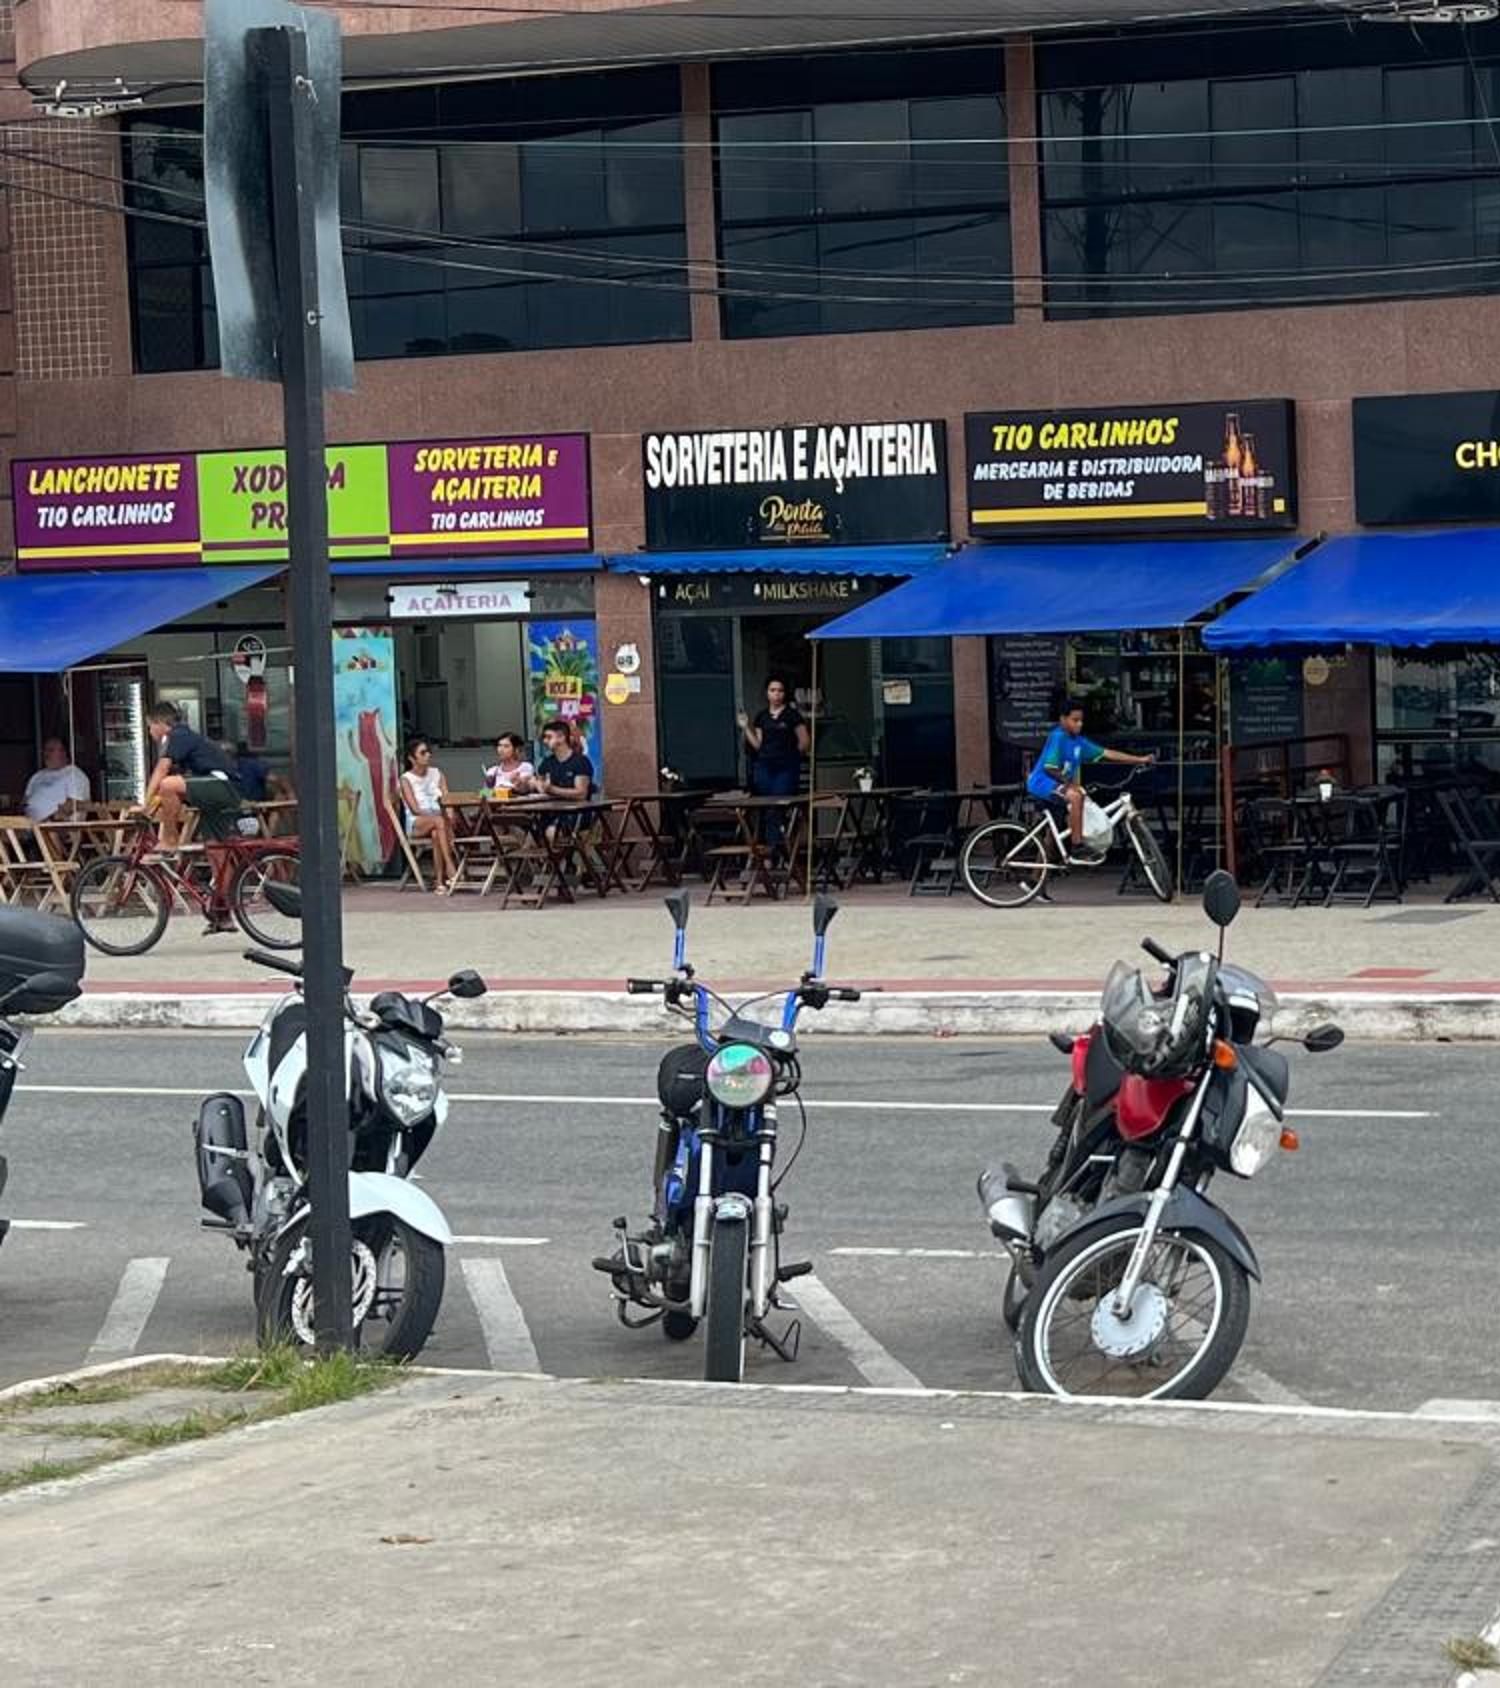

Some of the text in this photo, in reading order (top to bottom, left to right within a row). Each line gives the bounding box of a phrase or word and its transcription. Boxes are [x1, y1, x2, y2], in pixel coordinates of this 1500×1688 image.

[992, 417, 1179, 452] TIO CARLINHOS
[414, 444, 543, 473] SORVETERIA
[645, 422, 937, 494] SORVETERIA E AÇAITERIA
[973, 461, 1064, 482] MERCEARIA
[1068, 462, 1078, 477] E
[1082, 454, 1203, 477] DISTRIBUIDORA
[28, 463, 180, 496] LANCHONETE
[232, 464, 287, 494] XOD
[431, 475, 542, 505] AÇAITERIA
[1043, 479, 1134, 501] DE BEBIDAS
[37, 501, 174, 528] TIO CARLINHOS
[431, 508, 544, 531] TIO CARLINHOS
[759, 495, 824, 529] Ponta
[763, 580, 849, 600] MILKSHAKE
